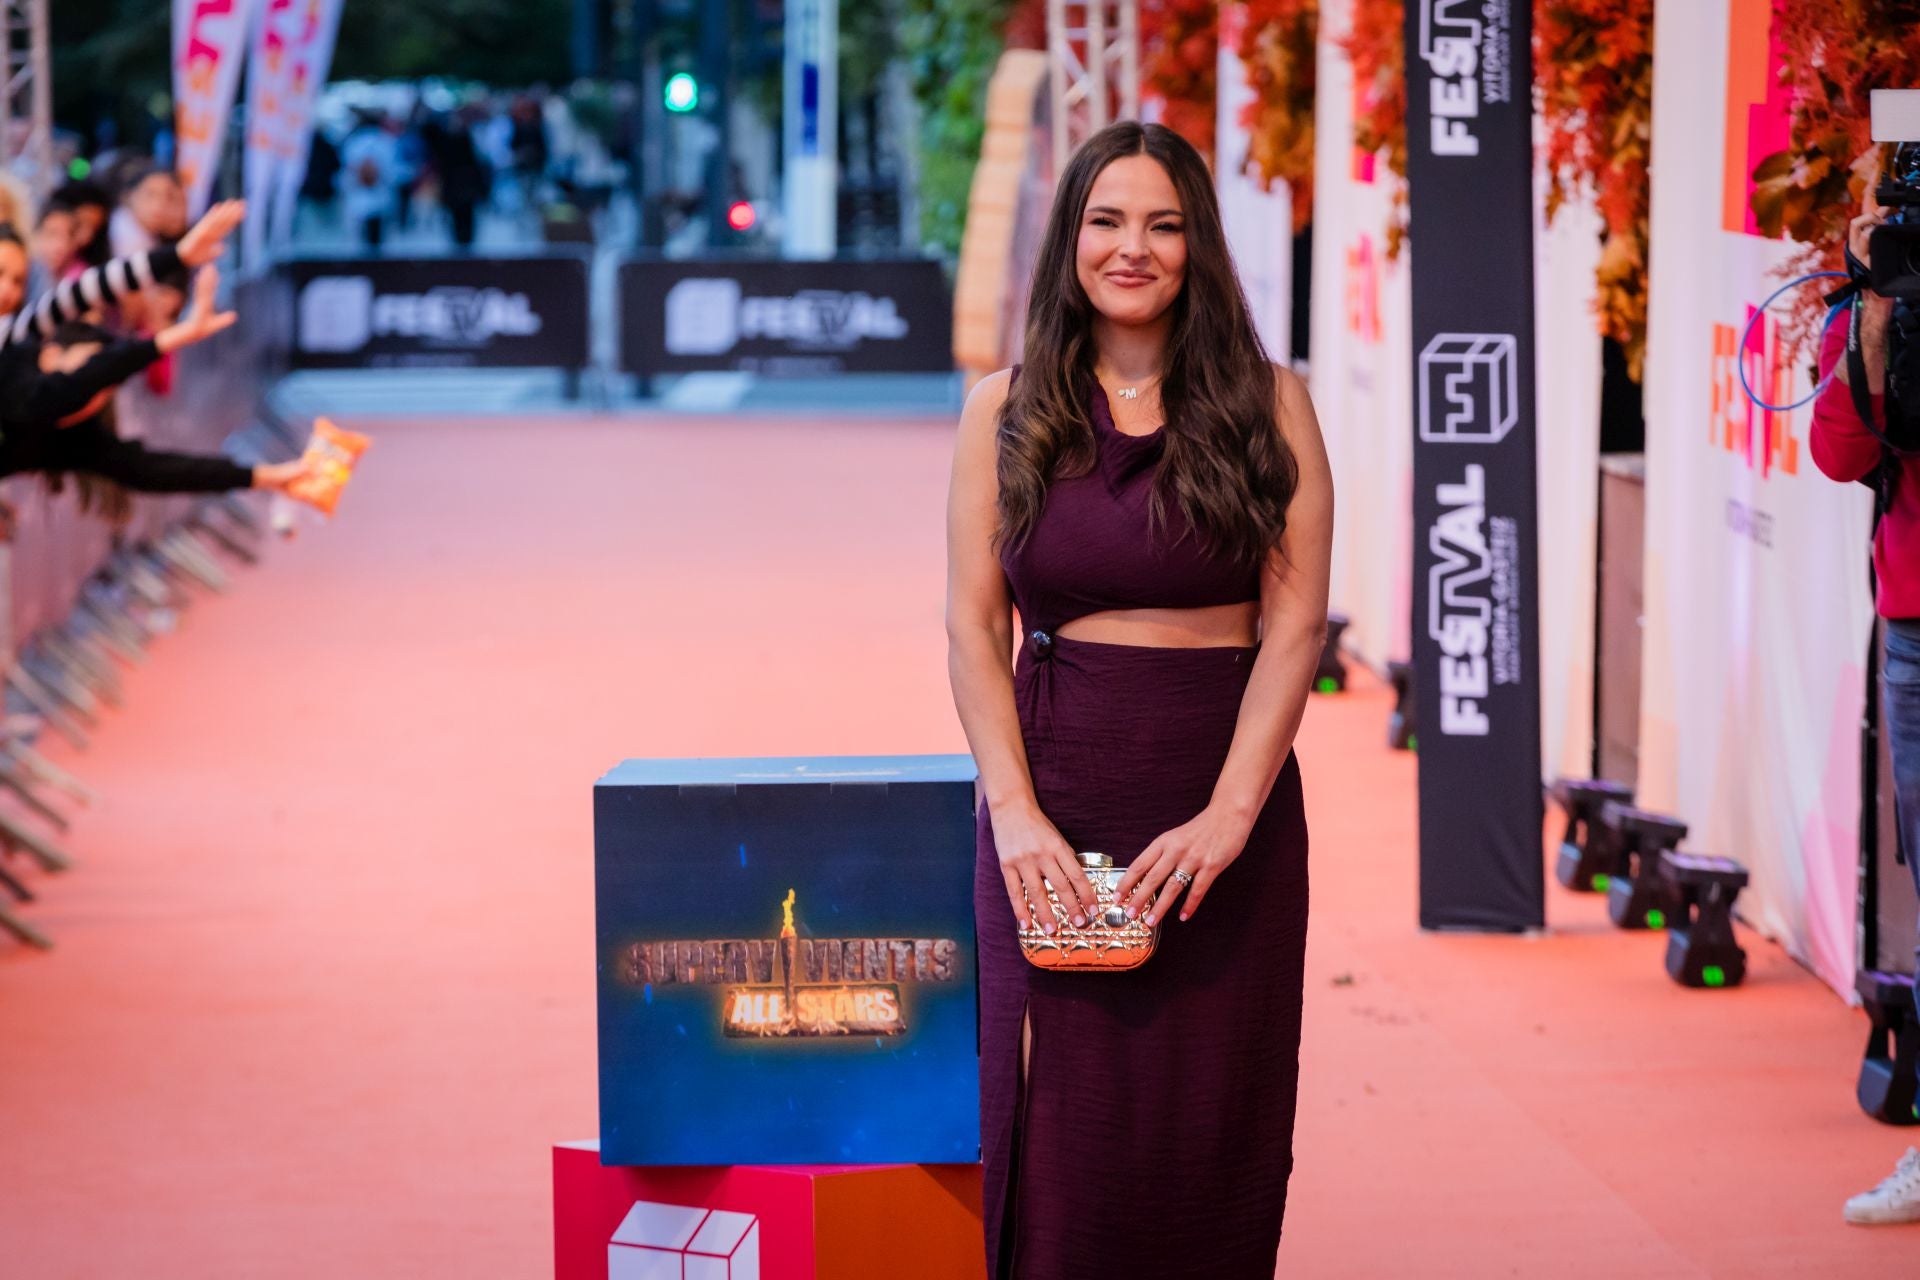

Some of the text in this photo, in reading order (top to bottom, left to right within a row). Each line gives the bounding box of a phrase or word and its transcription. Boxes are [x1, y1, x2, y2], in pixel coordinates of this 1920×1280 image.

[1428, 463, 1491, 736] FESTVAL
[731, 990, 899, 1025] ALL STARS
